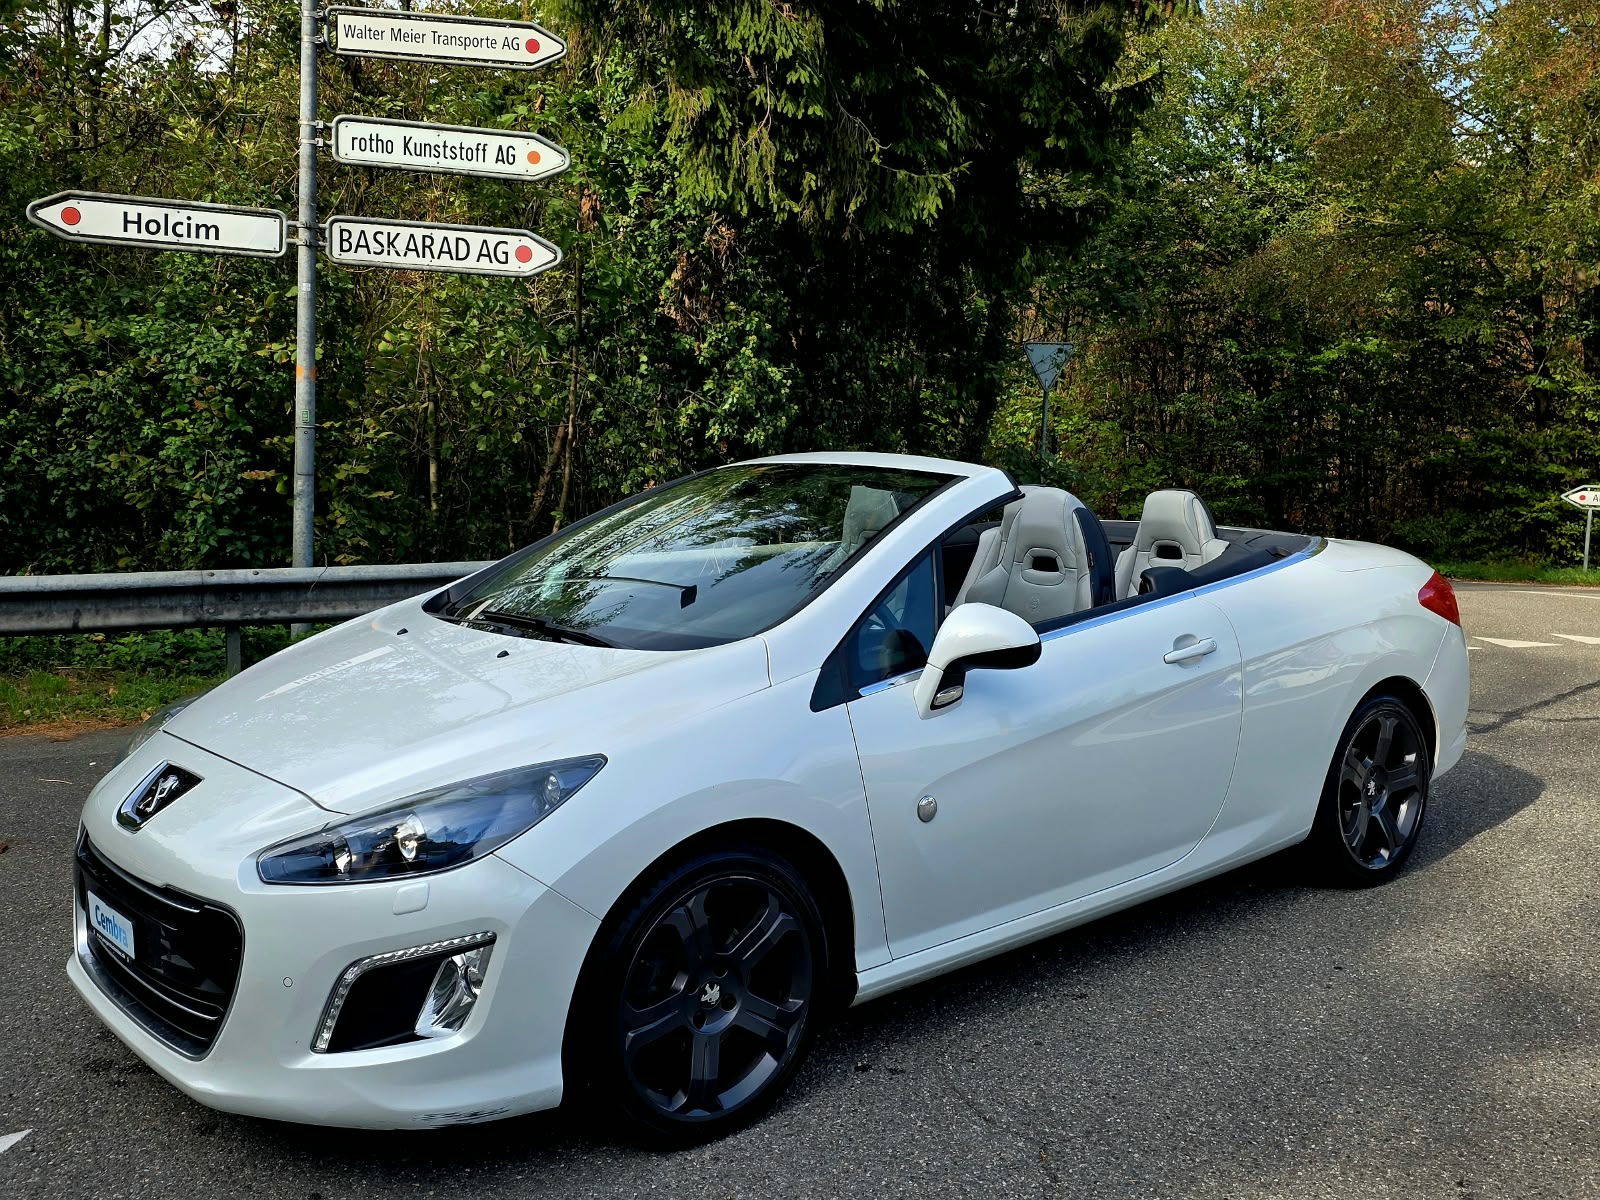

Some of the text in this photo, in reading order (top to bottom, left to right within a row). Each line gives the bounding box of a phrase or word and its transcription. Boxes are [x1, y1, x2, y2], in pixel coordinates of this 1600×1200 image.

[343, 23, 520, 51] Walter Meier Transporte AG
[351, 133, 516, 165] rotho Kunststoff AG
[123, 211, 220, 240] Holcim
[339, 228, 509, 265] BASKARAD AG
[95, 904, 128, 948] Cembra
